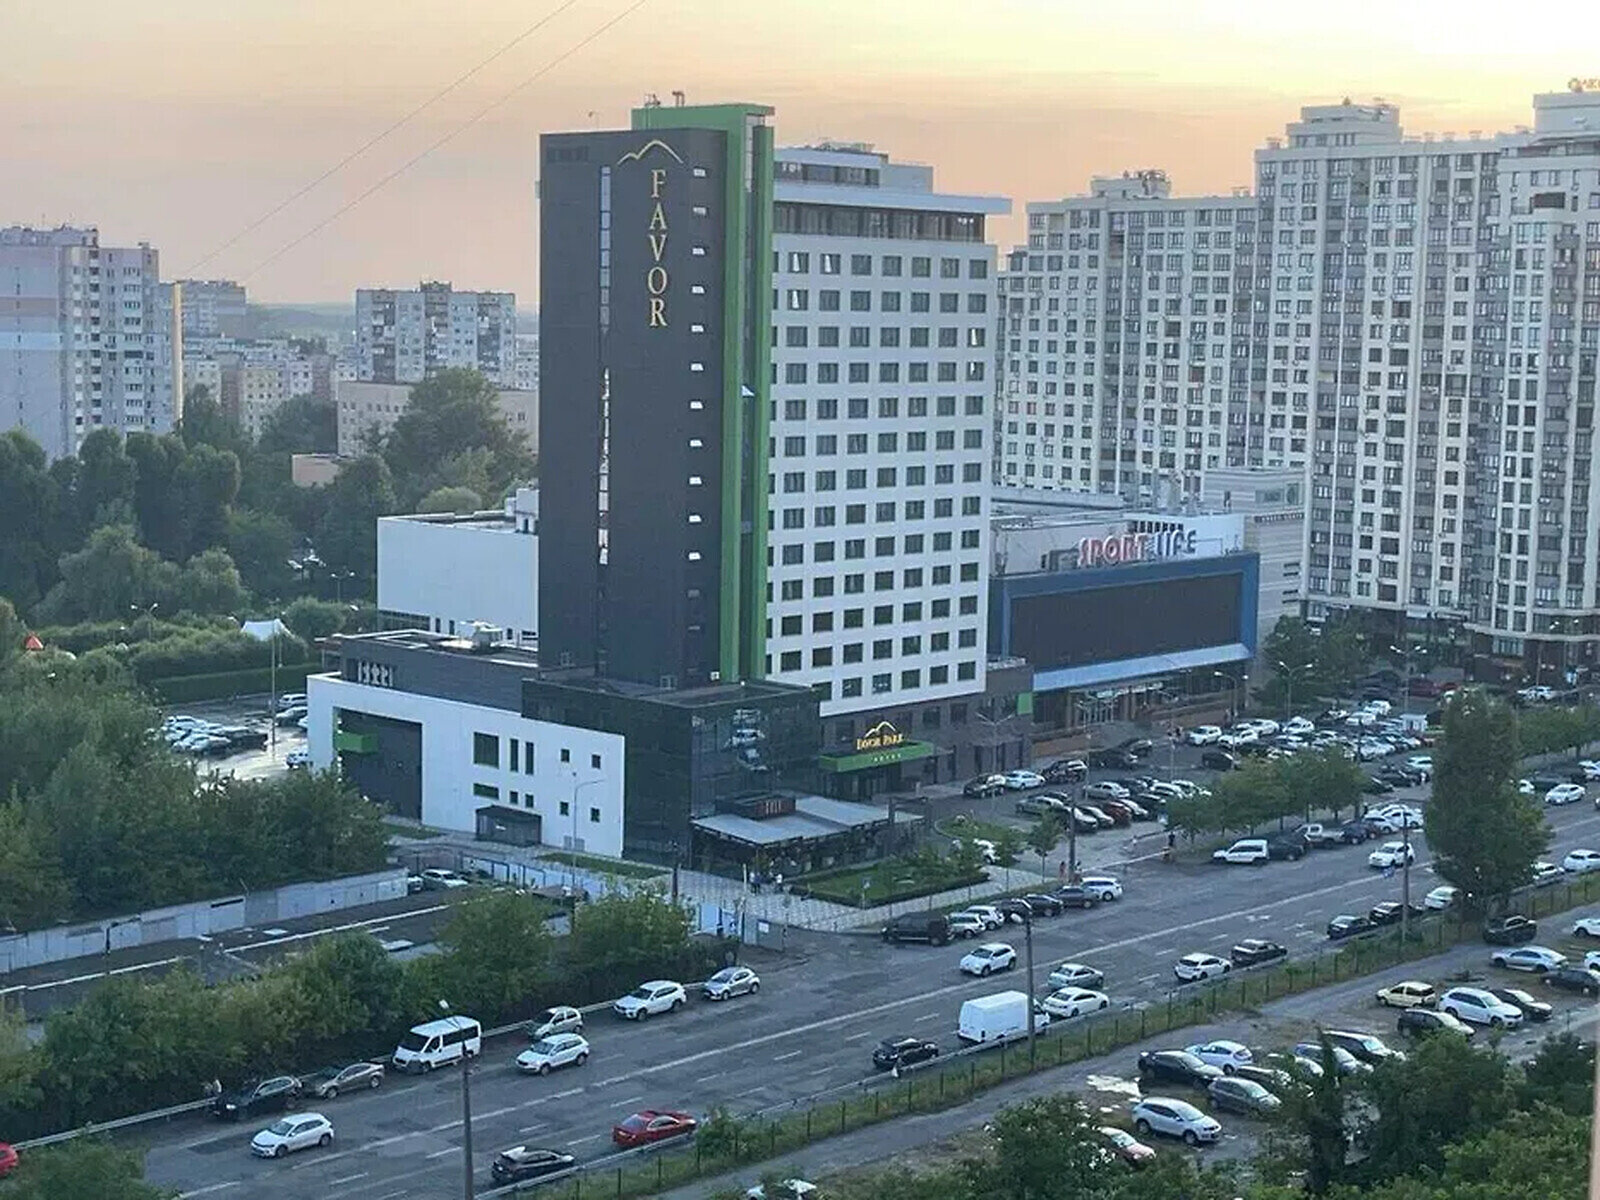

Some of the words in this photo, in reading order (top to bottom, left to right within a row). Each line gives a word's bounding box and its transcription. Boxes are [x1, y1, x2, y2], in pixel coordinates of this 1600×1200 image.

[648, 169, 667, 326] FAVOR
[1077, 533, 1146, 567] SPORT
[1154, 529, 1197, 556] LIFE
